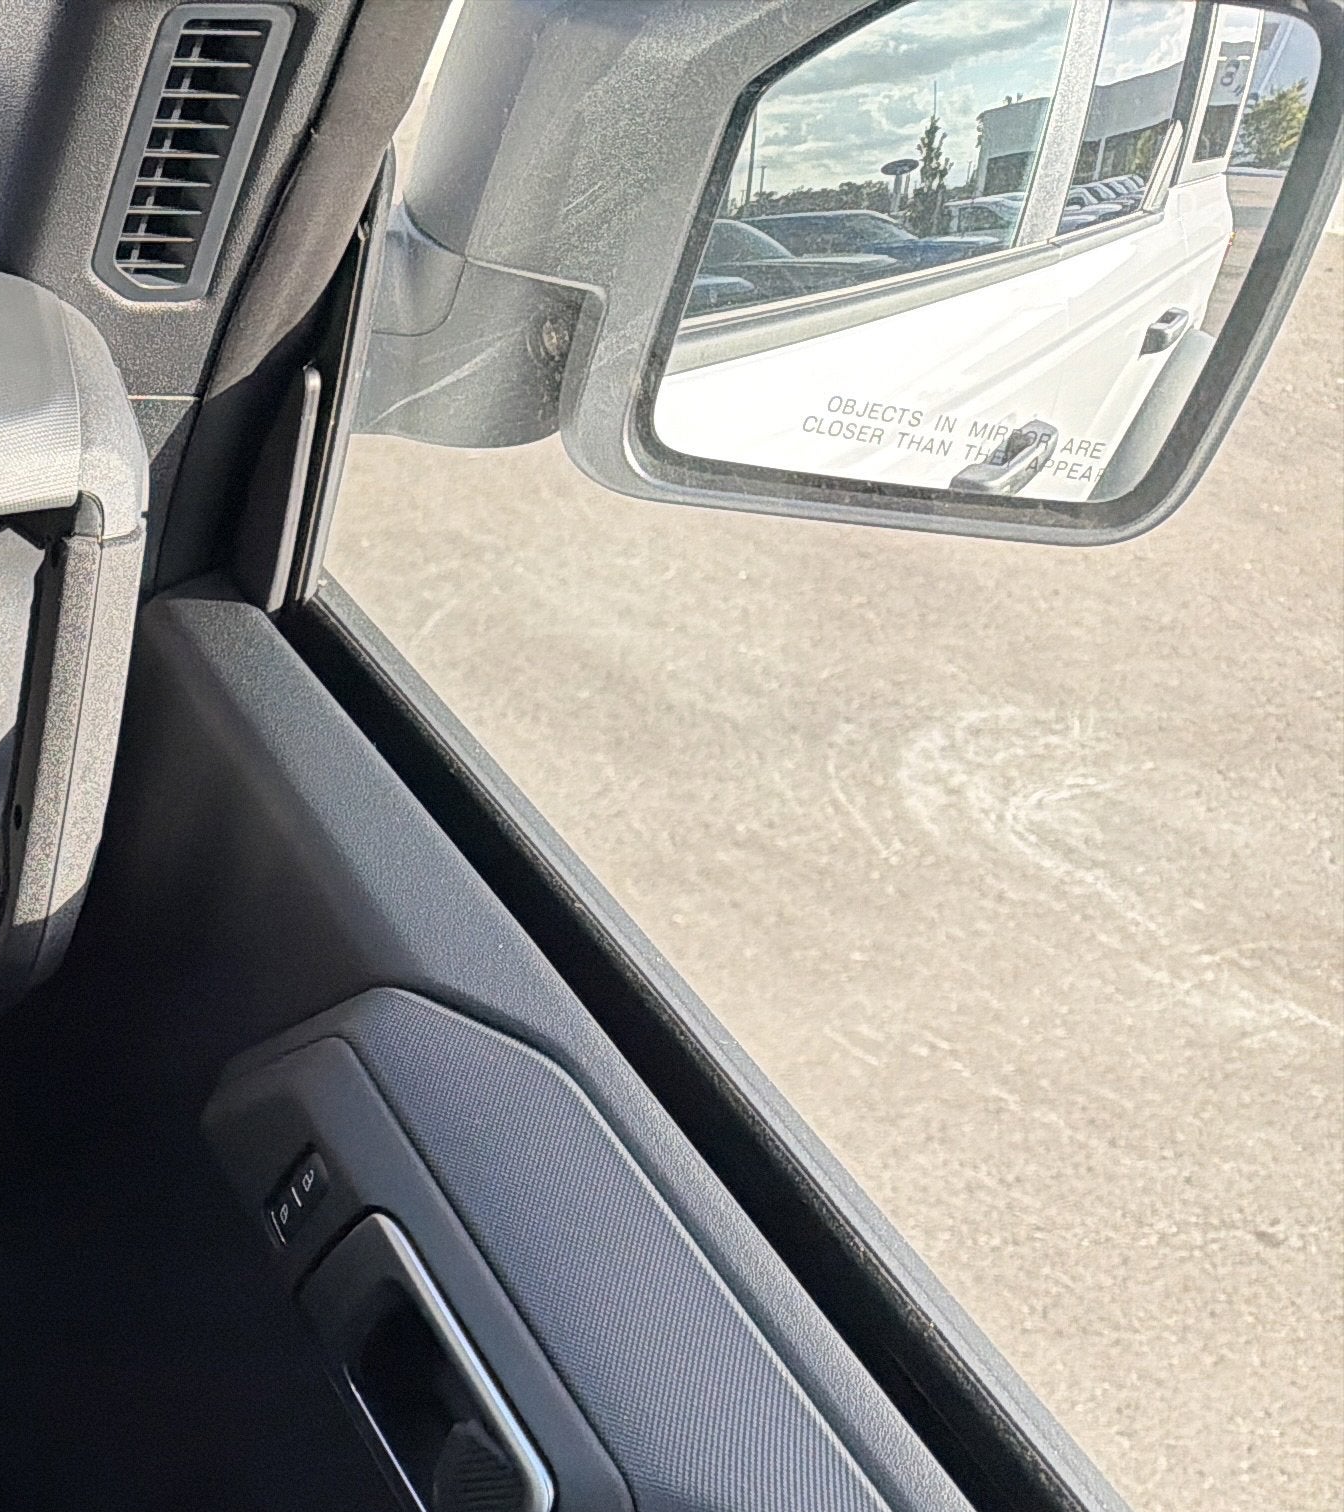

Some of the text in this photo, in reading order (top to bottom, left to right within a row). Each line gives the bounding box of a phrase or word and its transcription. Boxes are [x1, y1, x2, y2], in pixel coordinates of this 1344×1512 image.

[802, 415, 885, 445] CLOSER
[897, 431, 953, 456] THAN
[827, 395, 924, 428] OBJECTS
[934, 414, 958, 433] IN
[1060, 437, 1106, 459] ARE
